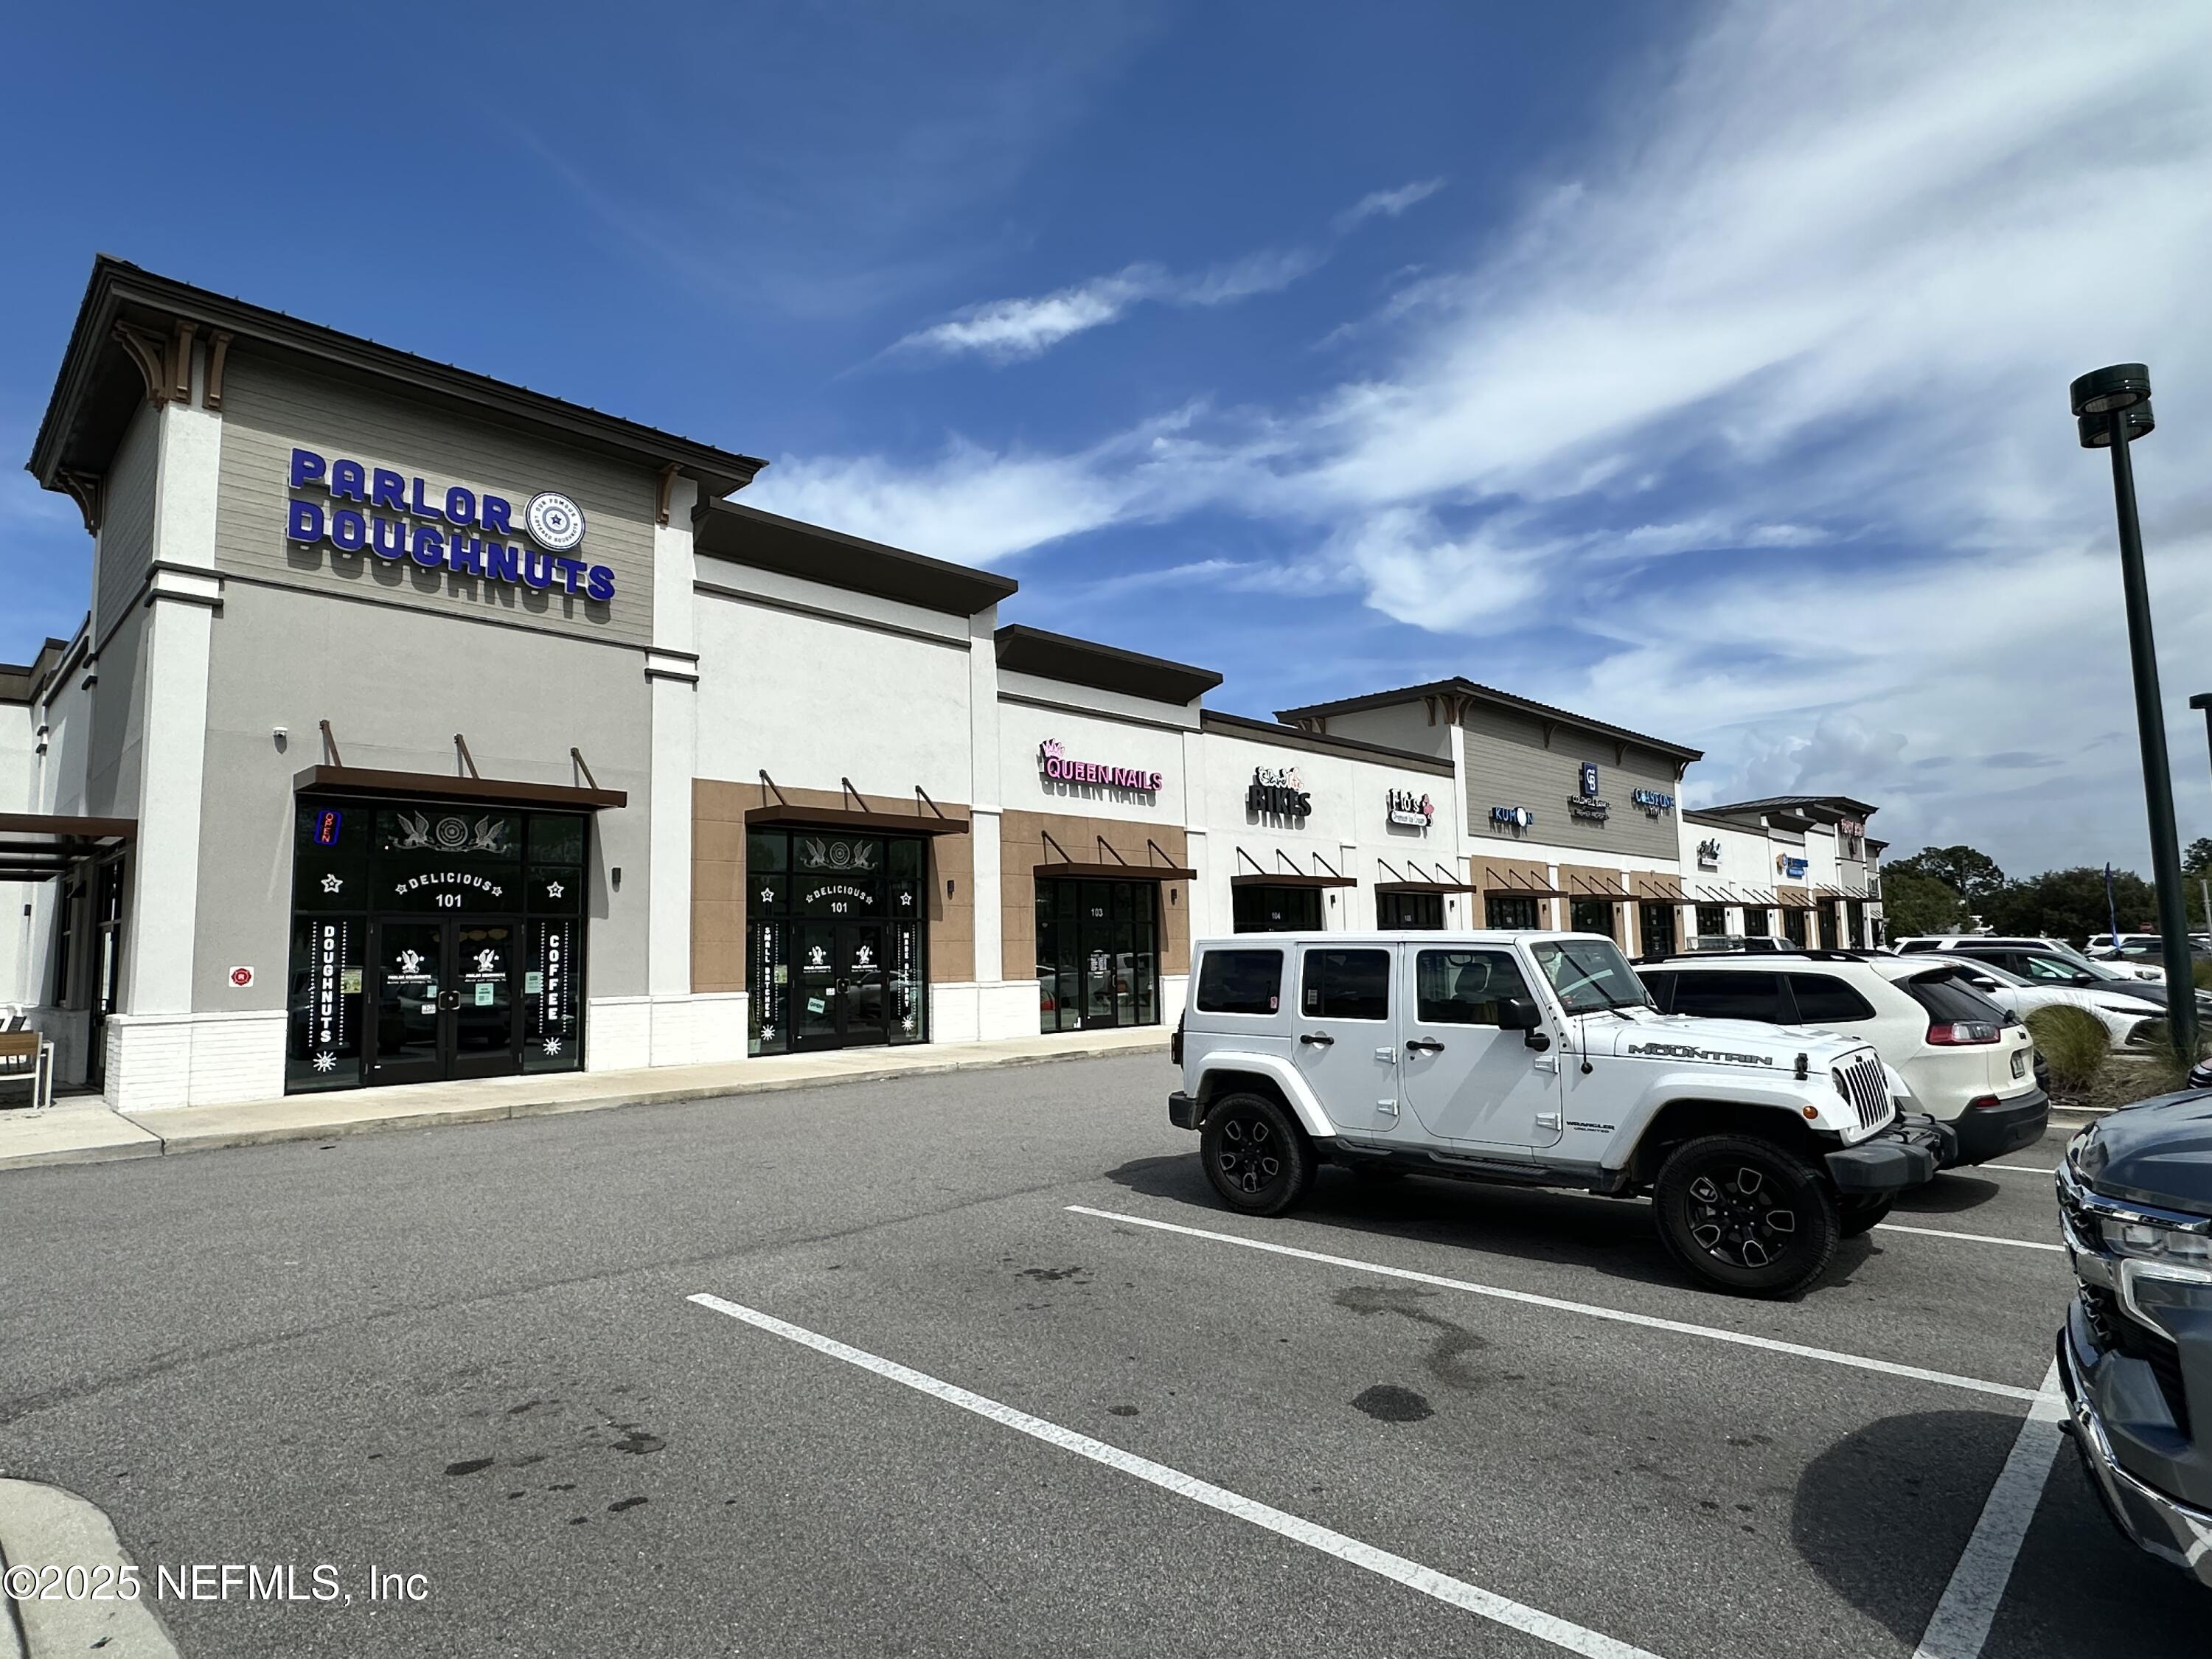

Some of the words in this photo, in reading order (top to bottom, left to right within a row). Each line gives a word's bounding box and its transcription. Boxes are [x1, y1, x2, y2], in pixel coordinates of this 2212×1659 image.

[288, 448, 512, 535] PARLOR
[287, 499, 616, 602] DOUGHNUTS
[1046, 758, 1110, 784] QUEEN
[1115, 767, 1163, 791] NAILS
[1249, 785, 1312, 817] BIKES
[1495, 807, 1534, 827] KUMON
[322, 813, 333, 843] OPEN
[408, 872, 492, 891] DELICIOUS
[436, 894, 462, 908] 101
[813, 885, 866, 900] DELICIOUS
[831, 902, 847, 913] 101
[1091, 908, 1103, 917] 103
[320, 925, 335, 1043] DOUGHNUTS
[548, 935, 560, 1020] COFFEE
[1628, 1044, 1773, 1065] MOUNTAIN
[1566, 1121, 1615, 1130] WRANGLER
